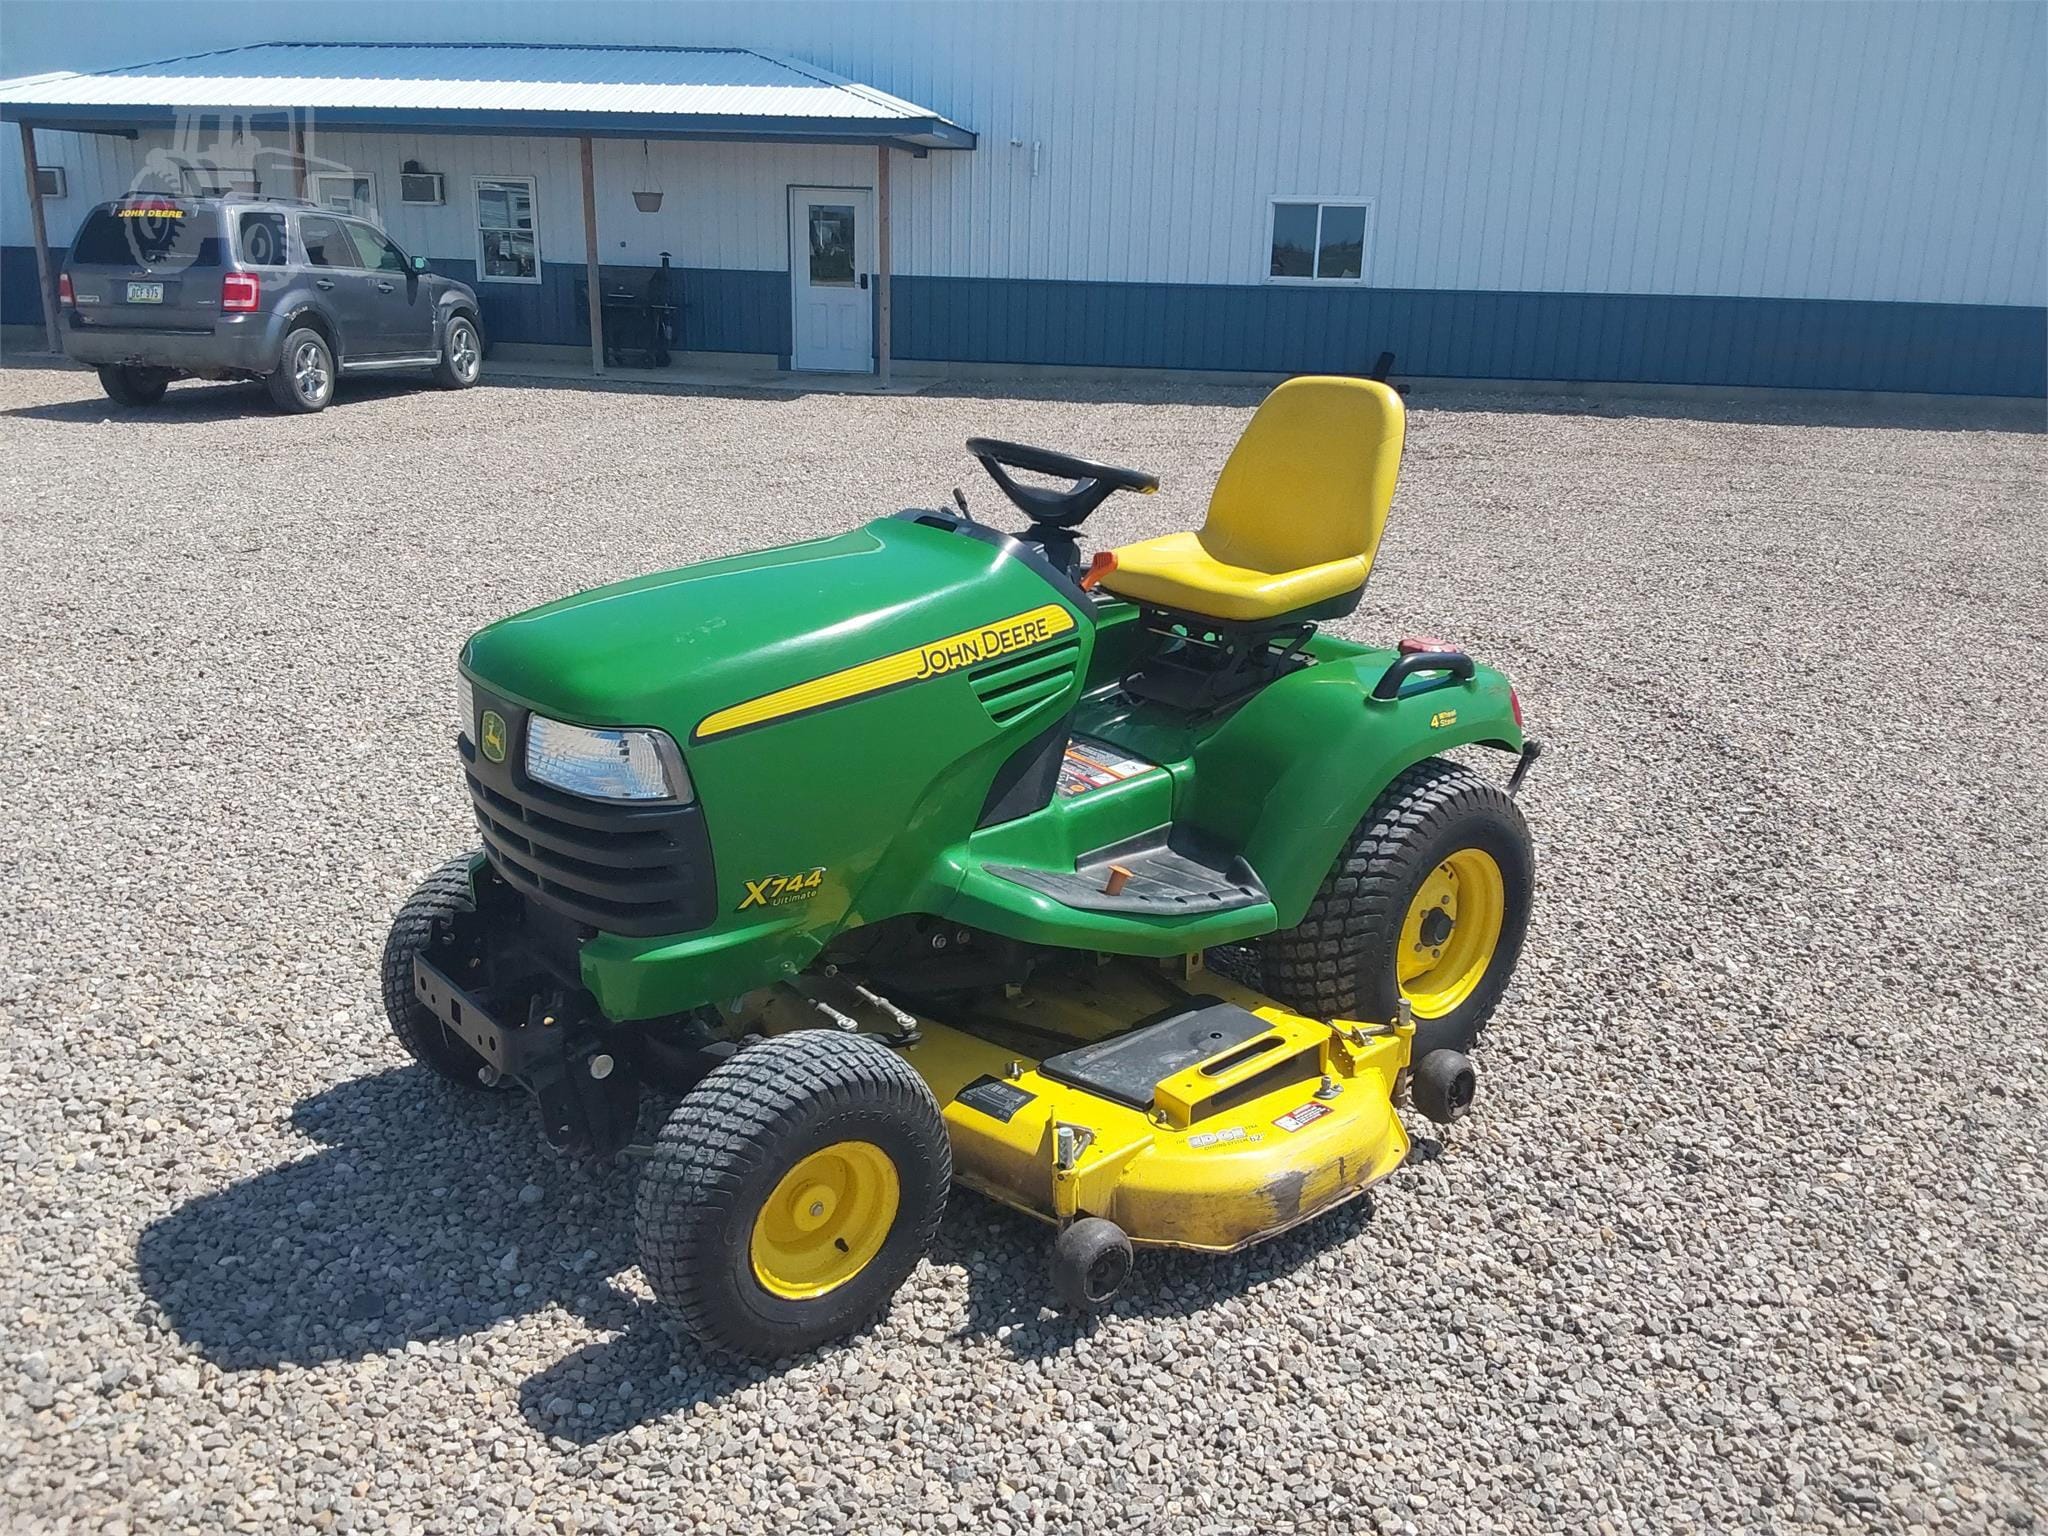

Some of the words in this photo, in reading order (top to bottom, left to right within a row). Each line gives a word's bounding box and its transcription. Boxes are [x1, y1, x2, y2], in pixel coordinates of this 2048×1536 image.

[118, 209, 146, 218] JOHN
[147, 209, 184, 219] DEERE
[917, 639, 980, 677] JOHN
[981, 617, 1050, 655] DEERE
[1430, 714, 1440, 728] 4
[737, 868, 823, 910] X744
[772, 890, 818, 907] Ultimate
[1189, 1128, 1246, 1148] EDGE
